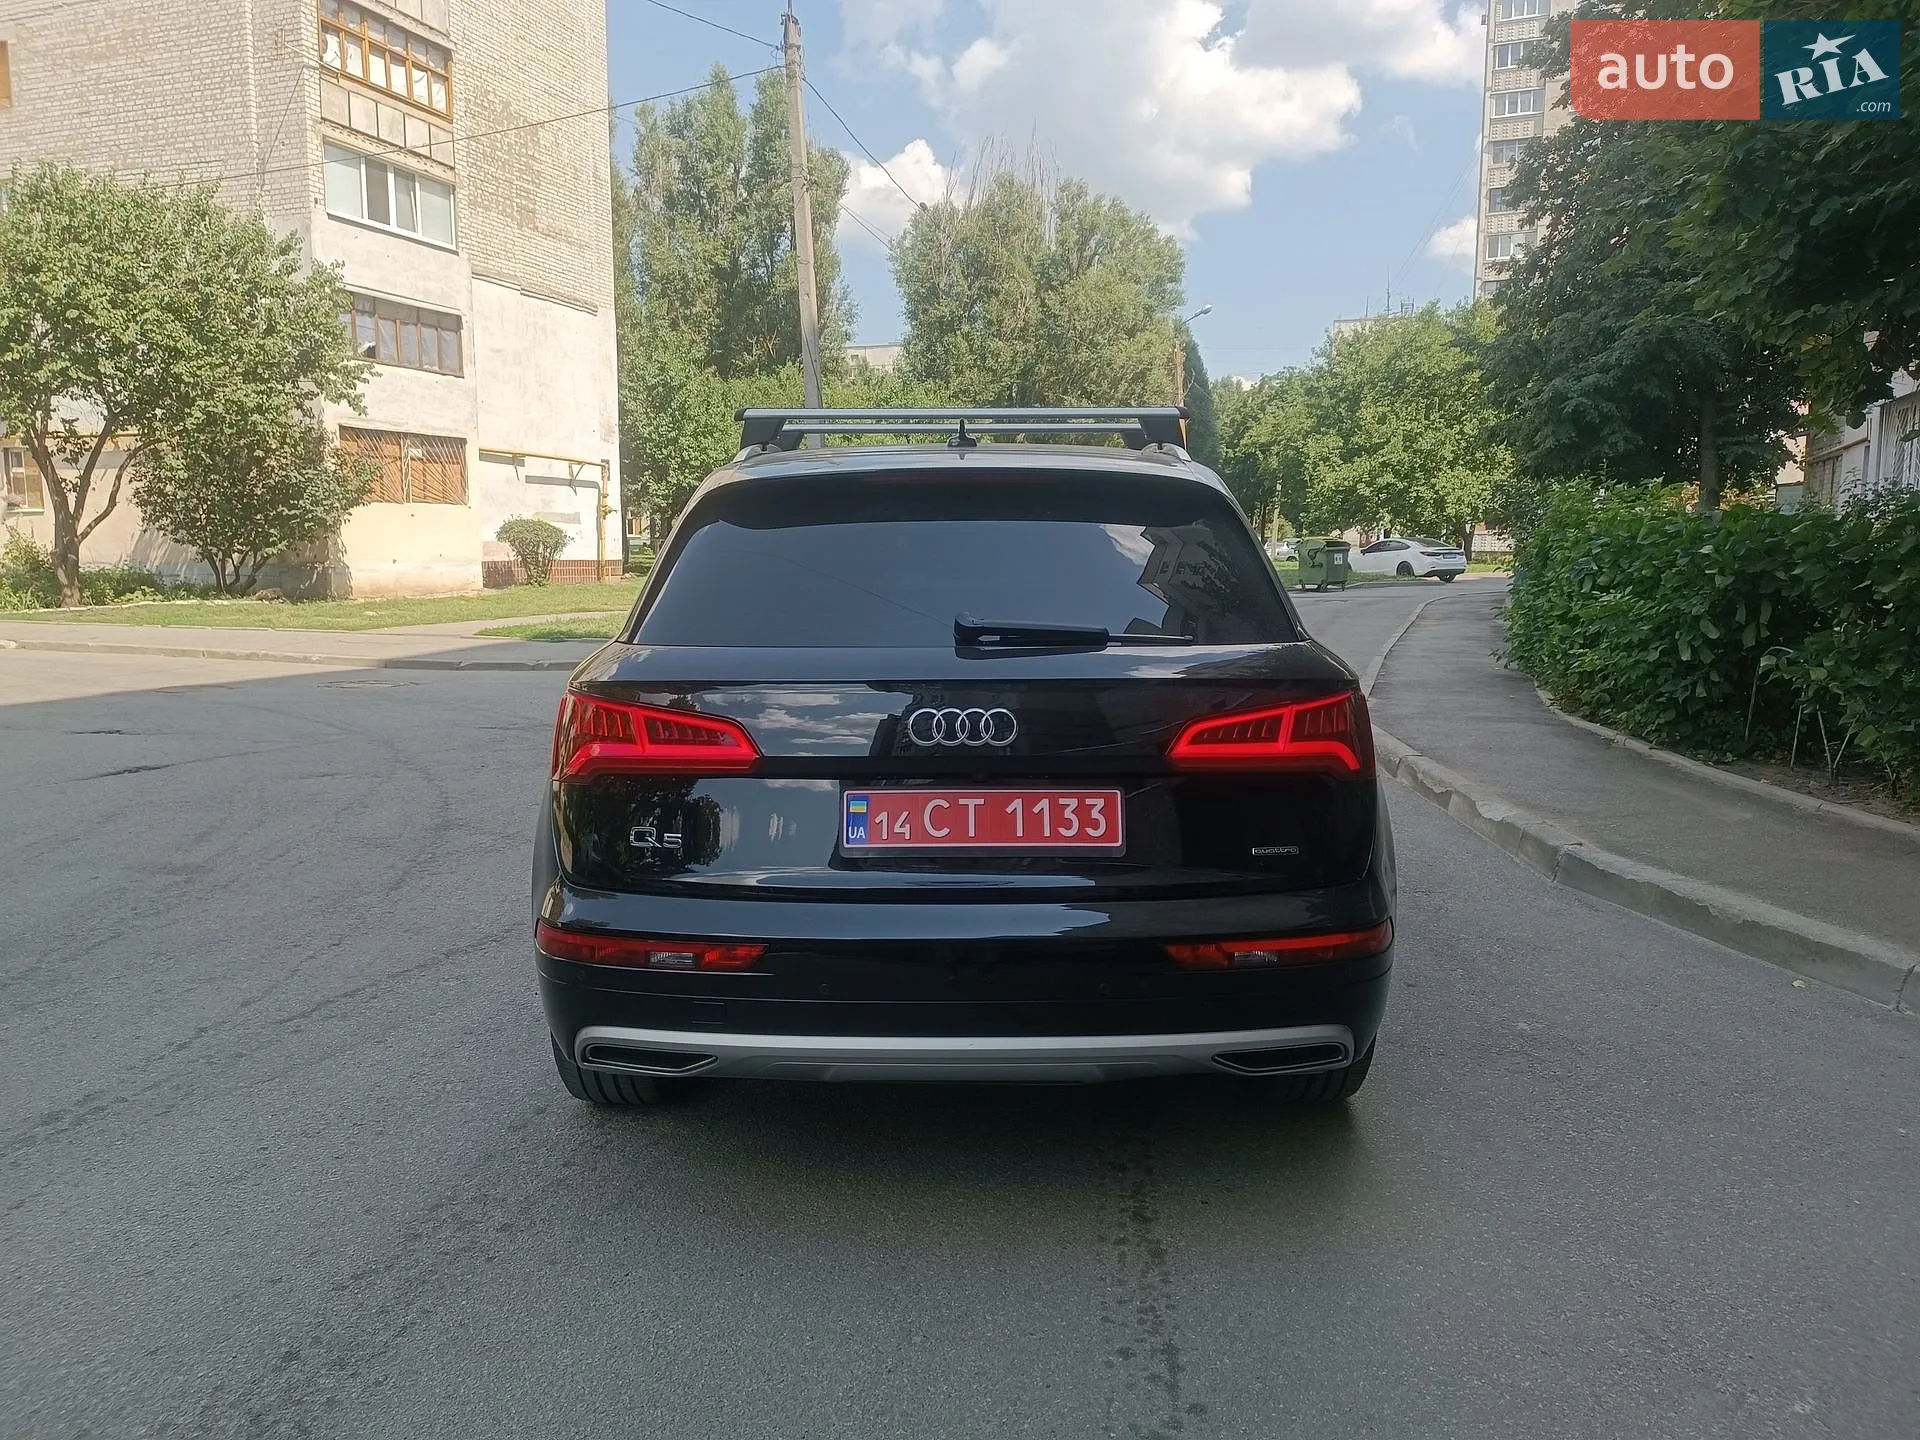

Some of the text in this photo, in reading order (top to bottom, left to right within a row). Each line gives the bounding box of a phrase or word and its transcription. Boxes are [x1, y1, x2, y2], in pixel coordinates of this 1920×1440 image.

[874, 811, 910, 840] 14
[1004, 798, 1107, 838] 1133
[629, 826, 682, 848] Q5
[848, 826, 866, 839] UA
